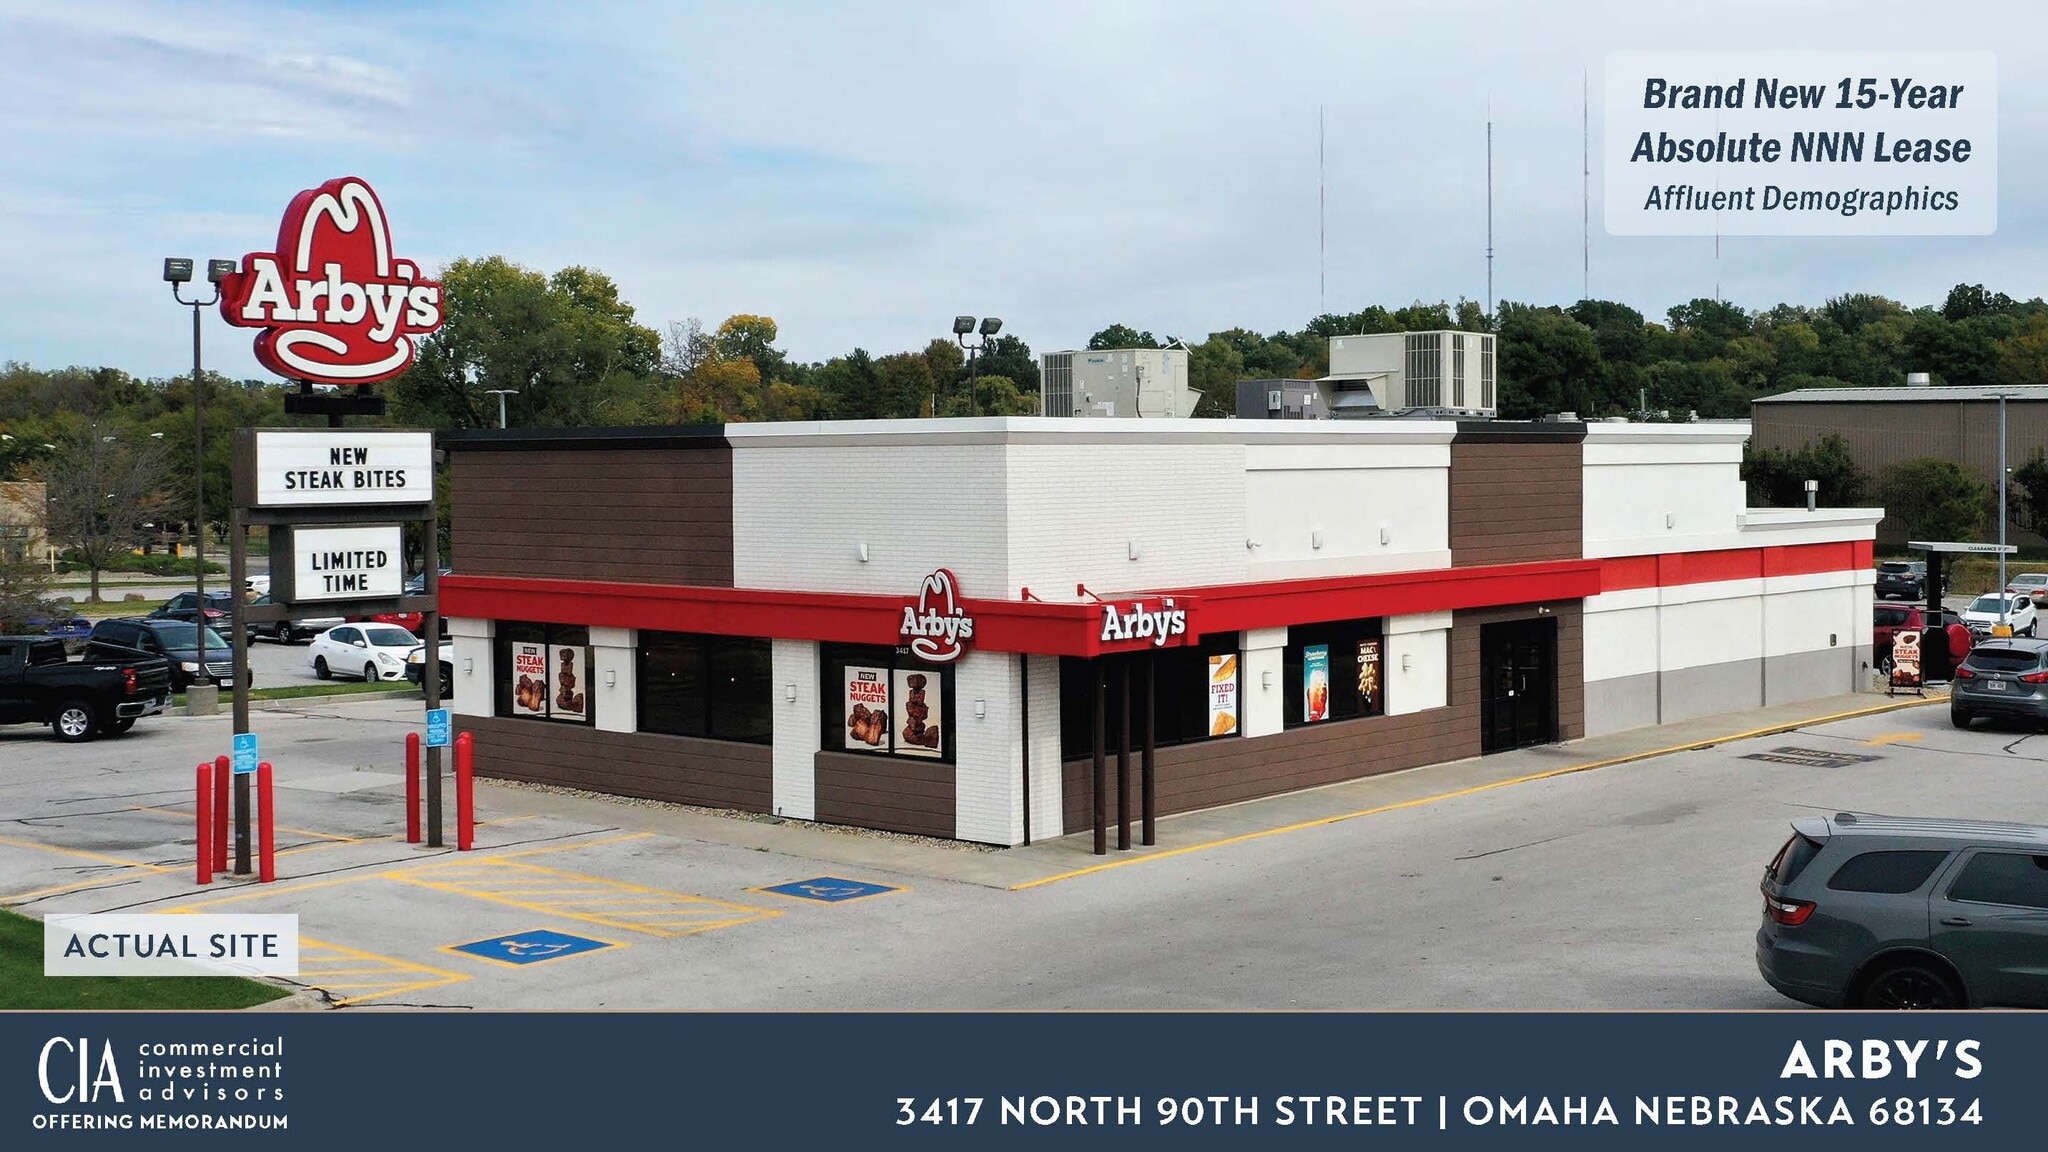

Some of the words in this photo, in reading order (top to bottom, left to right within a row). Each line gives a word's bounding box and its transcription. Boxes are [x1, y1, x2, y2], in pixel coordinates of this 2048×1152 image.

[242, 258, 440, 343] Arby's
[330, 447, 368, 466] NEW
[285, 471, 344, 489] STEAK
[354, 470, 406, 488] BITES
[312, 551, 388, 570] LIMITED
[324, 574, 369, 593] TIME
[900, 606, 973, 645] Arby's
[1101, 598, 1186, 646] Arby's
[516, 655, 544, 666] STEAK
[516, 665, 545, 674] NUGGETS
[850, 681, 886, 694] STEAK
[1211, 683, 1235, 694] FIXED
[850, 692, 886, 703] NUGGETS
